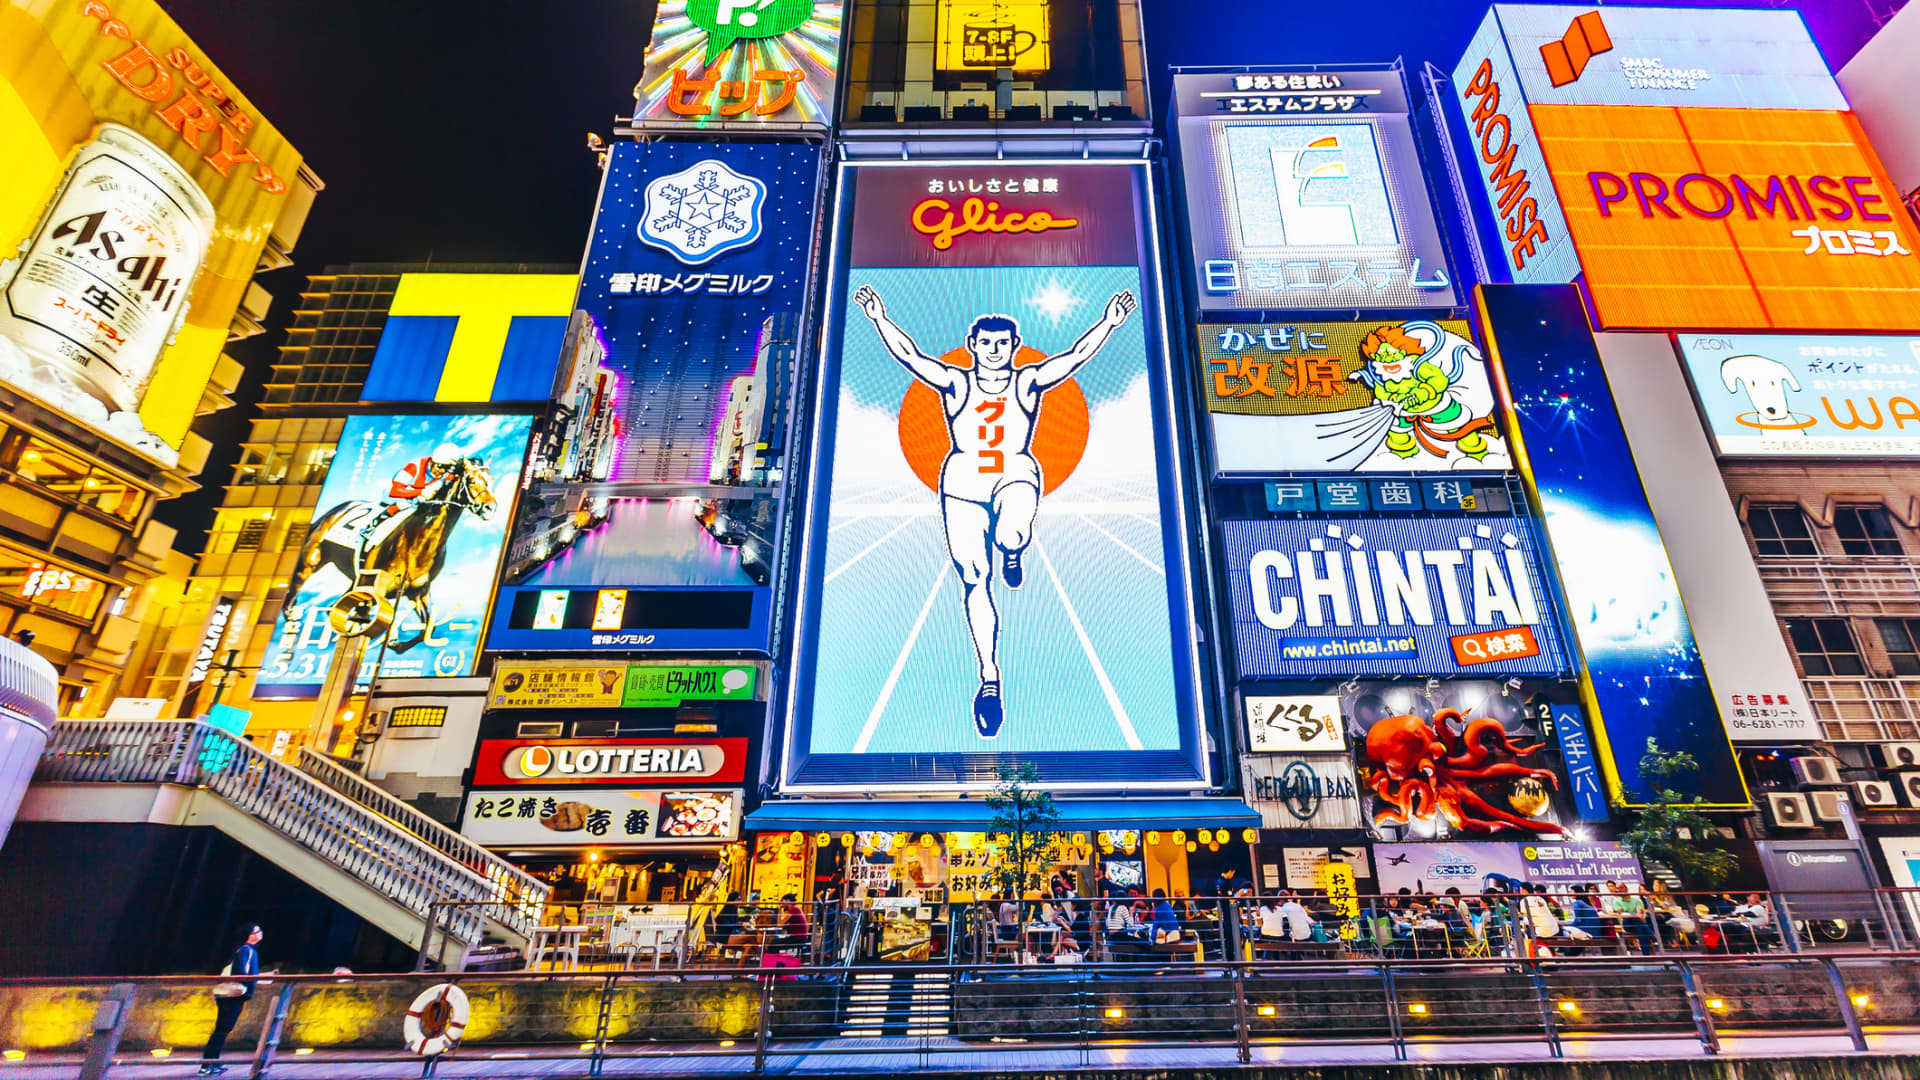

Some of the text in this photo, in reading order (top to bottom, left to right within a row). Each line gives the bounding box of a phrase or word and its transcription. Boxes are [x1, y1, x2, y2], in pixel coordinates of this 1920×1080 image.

[966, 30, 1014, 45] 7-8F
[1620, 57, 1661, 69] SMBC
[1624, 68, 1710, 80] CONSUMER
[167, 47, 254, 135] SUPER
[667, 68, 805, 116] ピップ
[1234, 75, 1341, 91] 夢ある住まい
[1629, 78, 1698, 90] FINANCE
[1229, 97, 1356, 112] エステムプラザ
[1464, 57, 1550, 271] PROMISE
[928, 178, 1059, 193] おいしさと健康
[1587, 171, 1893, 223] PROMISE
[912, 197, 1078, 250] Glico
[1792, 225, 1911, 257] プロミス
[51, 211, 182, 313] Asahi
[608, 272, 774, 296] 雪印メグミルク
[1204, 258, 1451, 293] 日商エステム
[81, 284, 120, 321] 生
[1219, 326, 1328, 351] かぜに
[1210, 355, 1349, 399] 改源
[974, 396, 1008, 474] グリコ
[1249, 524, 1541, 631] CHINTAI
[1486, 632, 1529, 655] 検索
[665, 670, 717, 694] ピタットハウス
[1731, 694, 1790, 706] 広告募集
[1266, 703, 1324, 743] くくる
[1733, 719, 1805, 729] 06-6281-1717
[557, 747, 704, 774] LOTTERIA
[474, 796, 558, 819] たこ焼き
[950, 850, 990, 868] 串カツ
[1563, 846, 1594, 863] Rapid
[1528, 866, 1540, 877] to
[1540, 864, 1576, 876] Kansai
[1600, 863, 1638, 880] Airport
